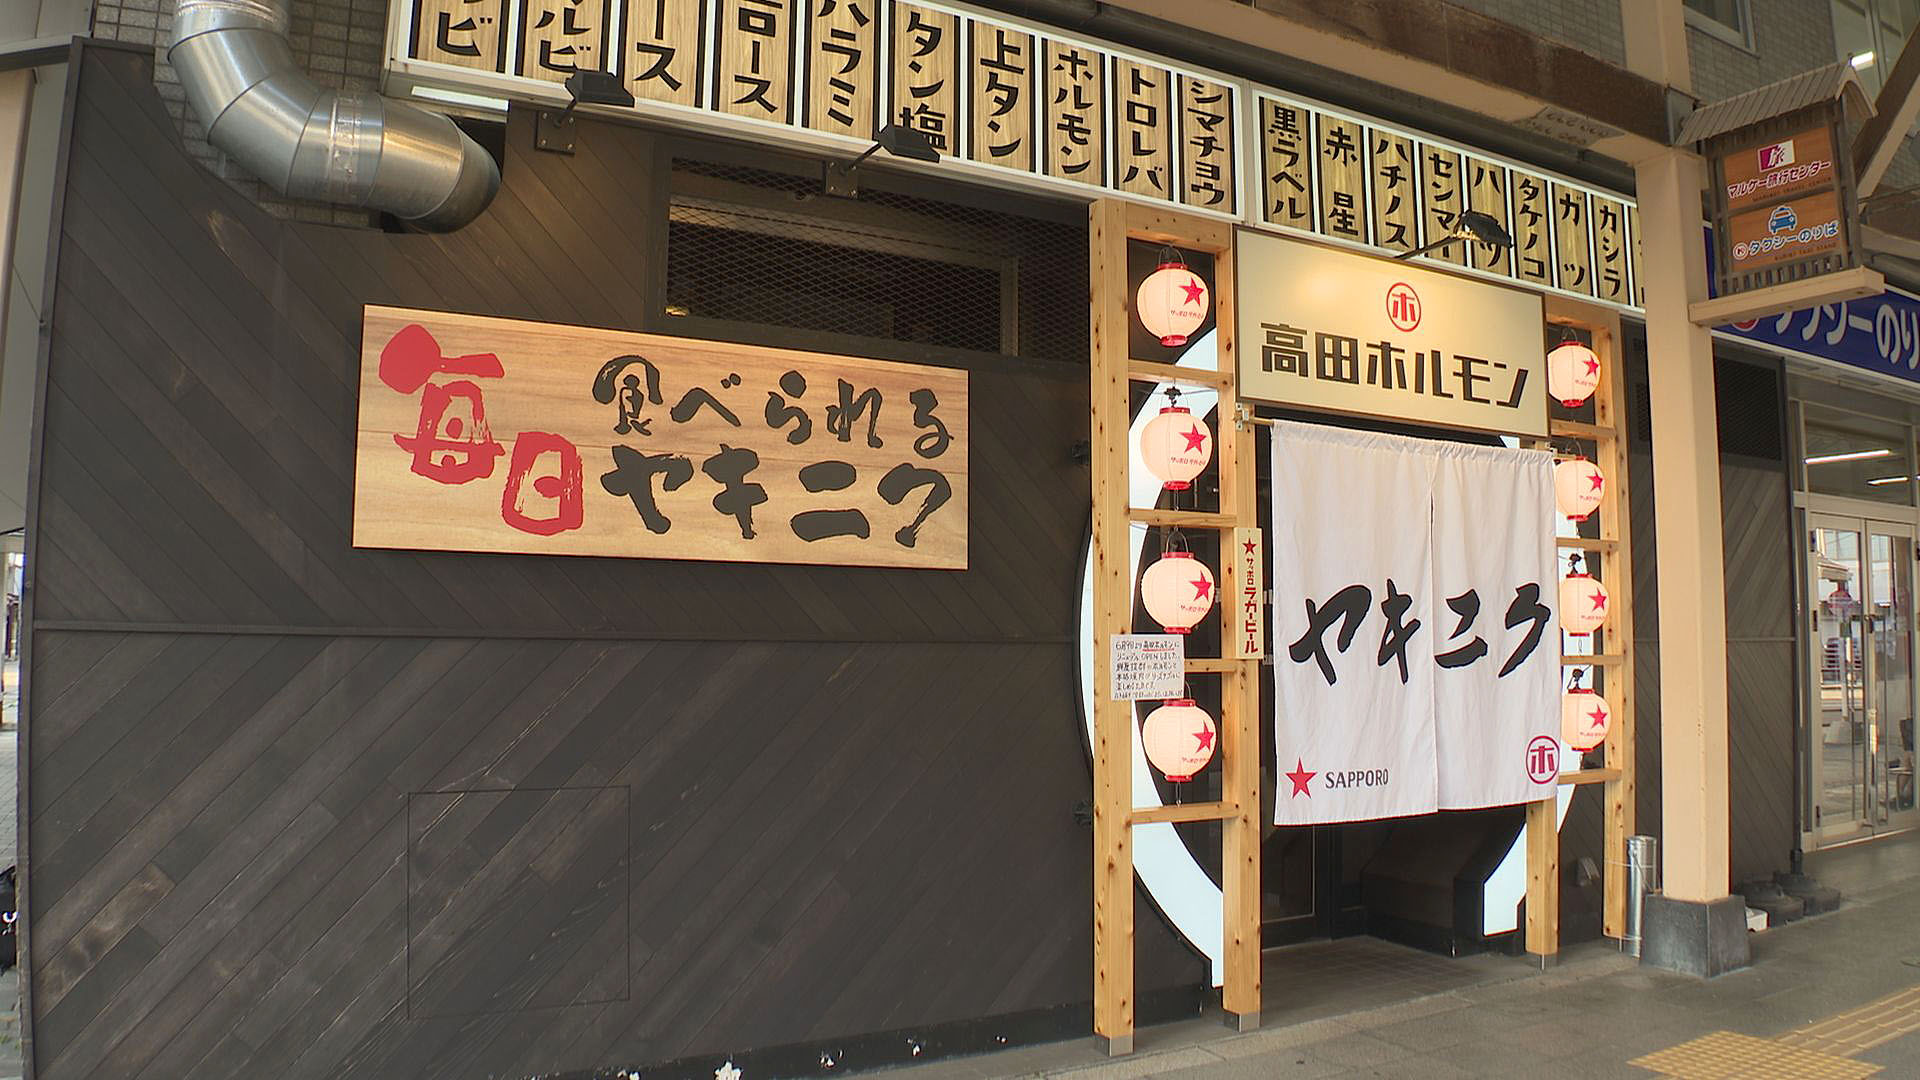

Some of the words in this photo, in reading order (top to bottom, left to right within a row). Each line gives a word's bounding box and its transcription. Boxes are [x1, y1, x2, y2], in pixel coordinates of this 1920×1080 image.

[437, 0, 493, 57] ビ
[534, 0, 592, 74] ルビ
[733, 0, 784, 114] ロース
[817, 0, 870, 127] ハラミ
[899, 11, 948, 151] タン塩
[979, 29, 1025, 158] 上タン
[1053, 49, 1094, 175] ホルモン
[1122, 68, 1164, 192] トロレバ
[1267, 104, 1306, 219] 黒ラベル
[1324, 126, 1359, 237] 赤星
[1376, 138, 1410, 248] ハチノス
[1474, 166, 1502, 268] ハツ
[1518, 178, 1546, 279] タケノコ
[1559, 192, 1586, 286] ガツ
[1600, 204, 1622, 297] カシラ
[592, 354, 954, 459] 食べられる
[1260, 322, 1529, 409] 高田ホルモン
[379, 324, 584, 536] 毎日
[600, 444, 952, 548] ヤキニク
[1289, 578, 1551, 686] ヤキニク
[1325, 768, 1389, 789] SAPPORO
